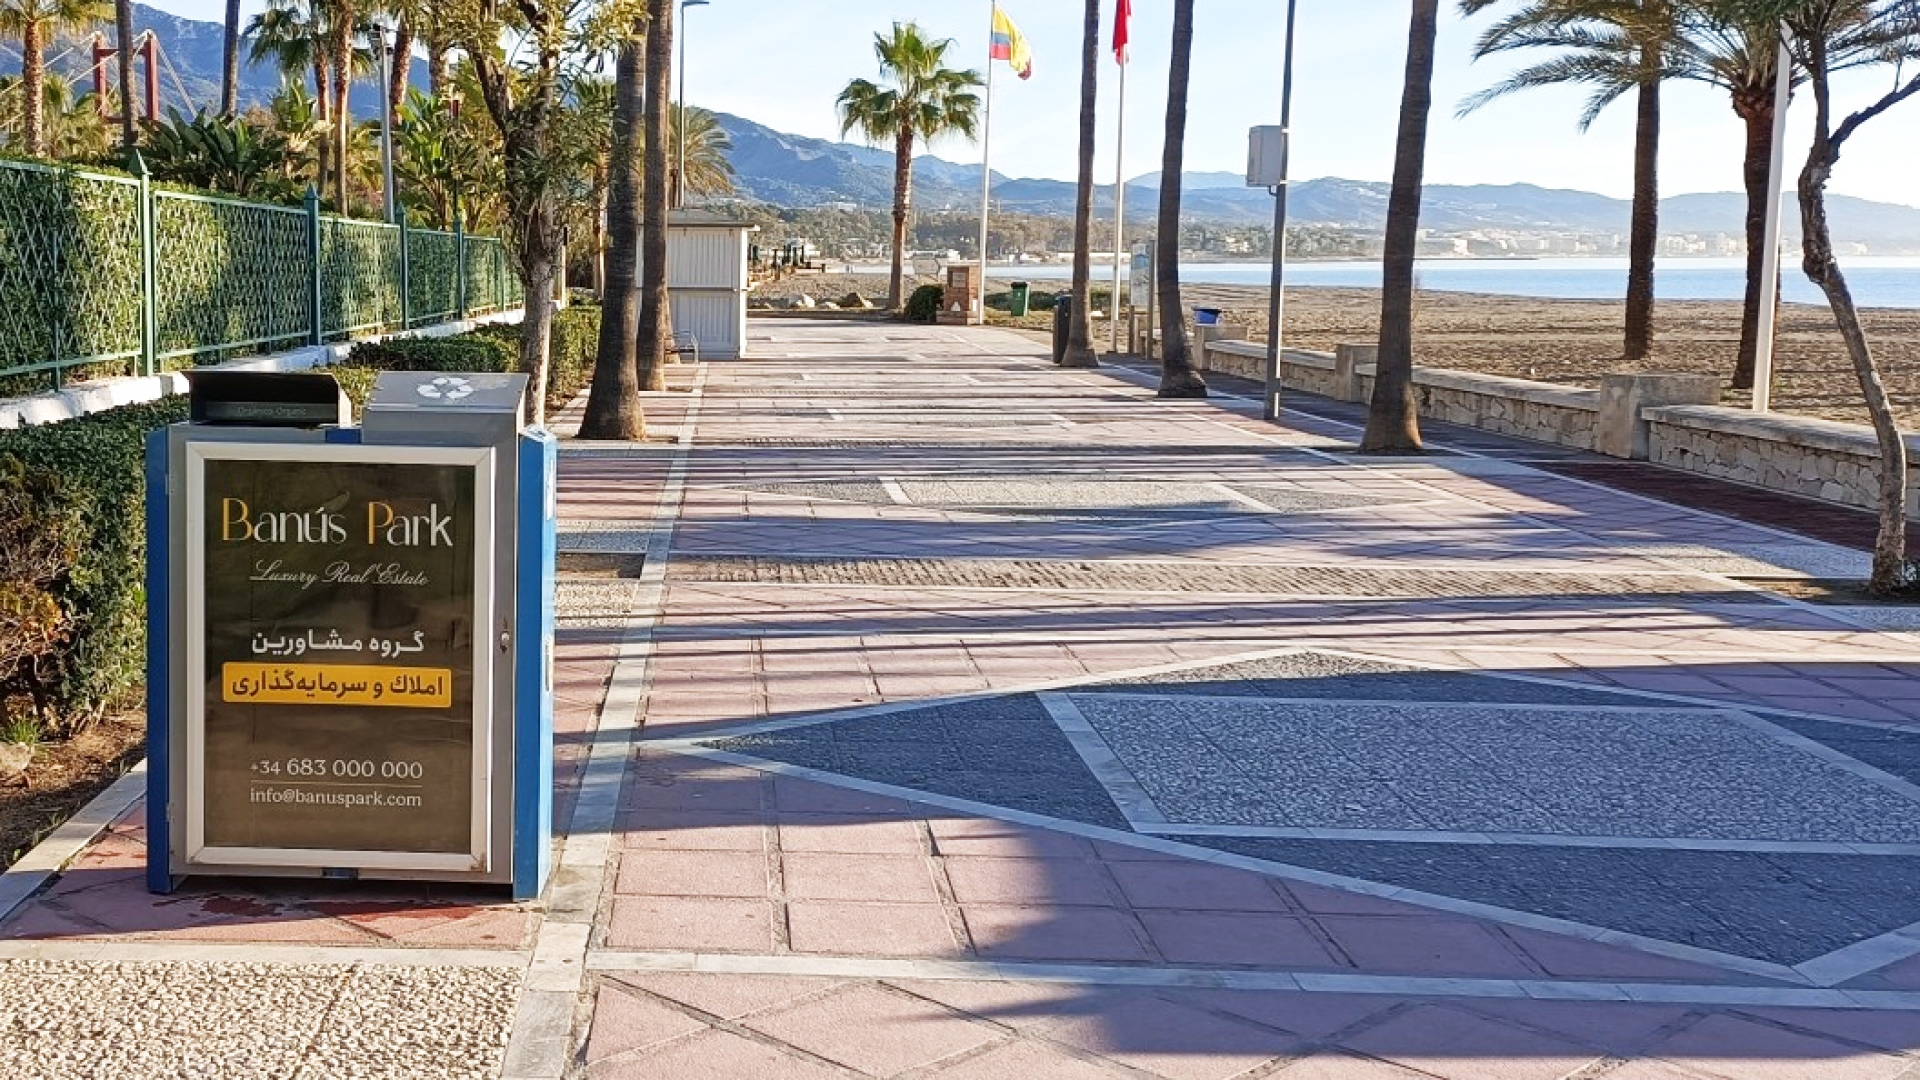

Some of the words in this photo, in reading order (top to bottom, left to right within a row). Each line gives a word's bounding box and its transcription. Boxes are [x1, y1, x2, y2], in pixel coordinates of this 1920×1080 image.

[222, 498, 347, 544] Banús
[368, 501, 454, 547] Park
[249, 559, 318, 589] Luxury
[322, 560, 377, 583] Real
[373, 563, 429, 586] Estate
[251, 629, 363, 655] مشاورین
[368, 630, 425, 658] گروه
[372, 680, 384, 698] و
[250, 761, 281, 776] +34
[286, 758, 327, 777] 683
[332, 759, 375, 778] 000
[381, 761, 423, 779] 000
[250, 788, 422, 807] info@banuspark.com
